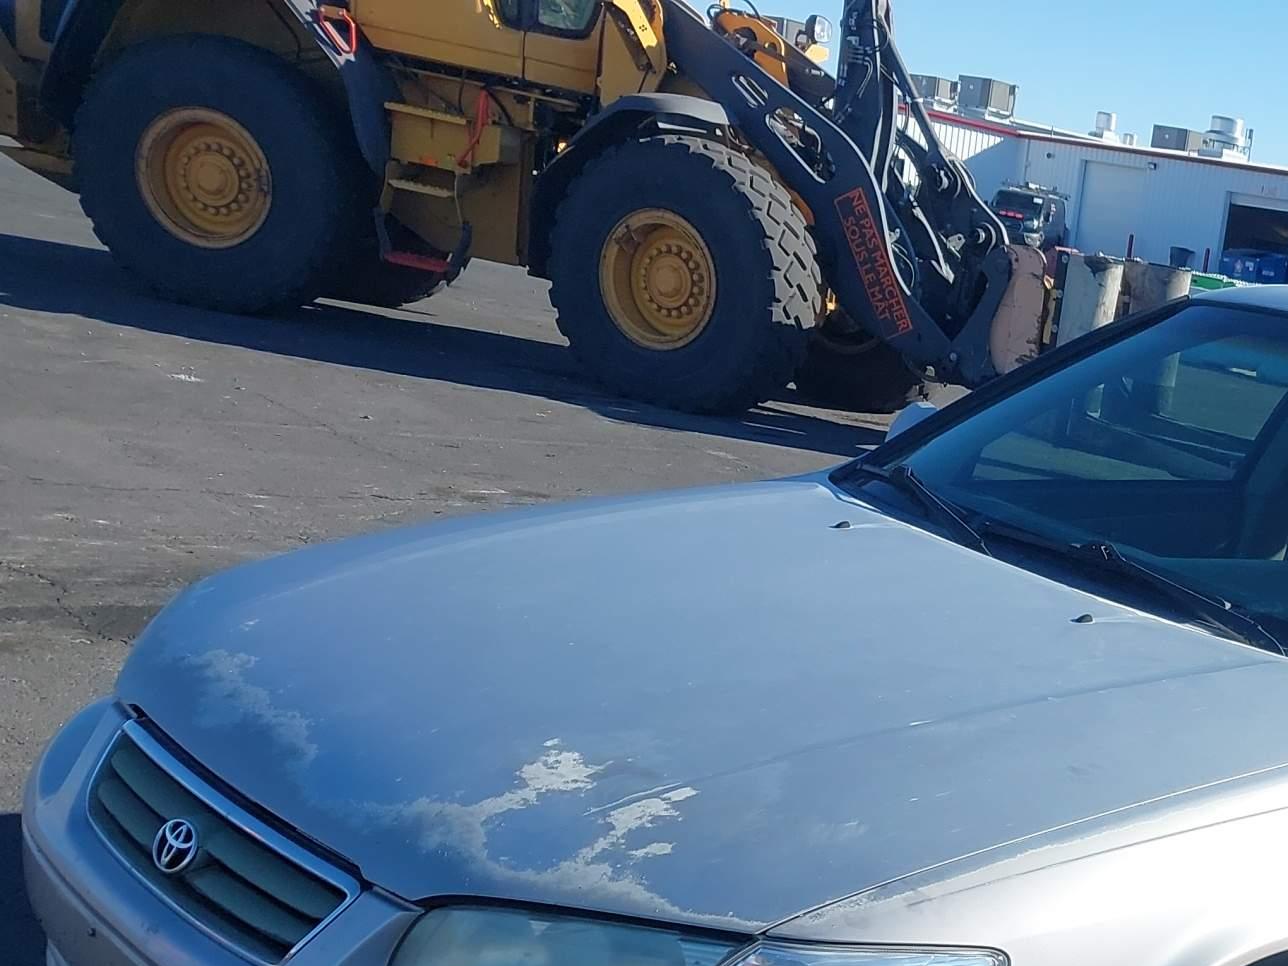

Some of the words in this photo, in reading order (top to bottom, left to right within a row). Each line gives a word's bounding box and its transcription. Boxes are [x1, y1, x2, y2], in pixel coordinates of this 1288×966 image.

[844, 216, 868, 262] SOUS
[861, 263, 877, 285] LE
[850, 191, 866, 215] NE
[860, 219, 878, 248] PAS
[872, 250, 909, 331] MARCHER
